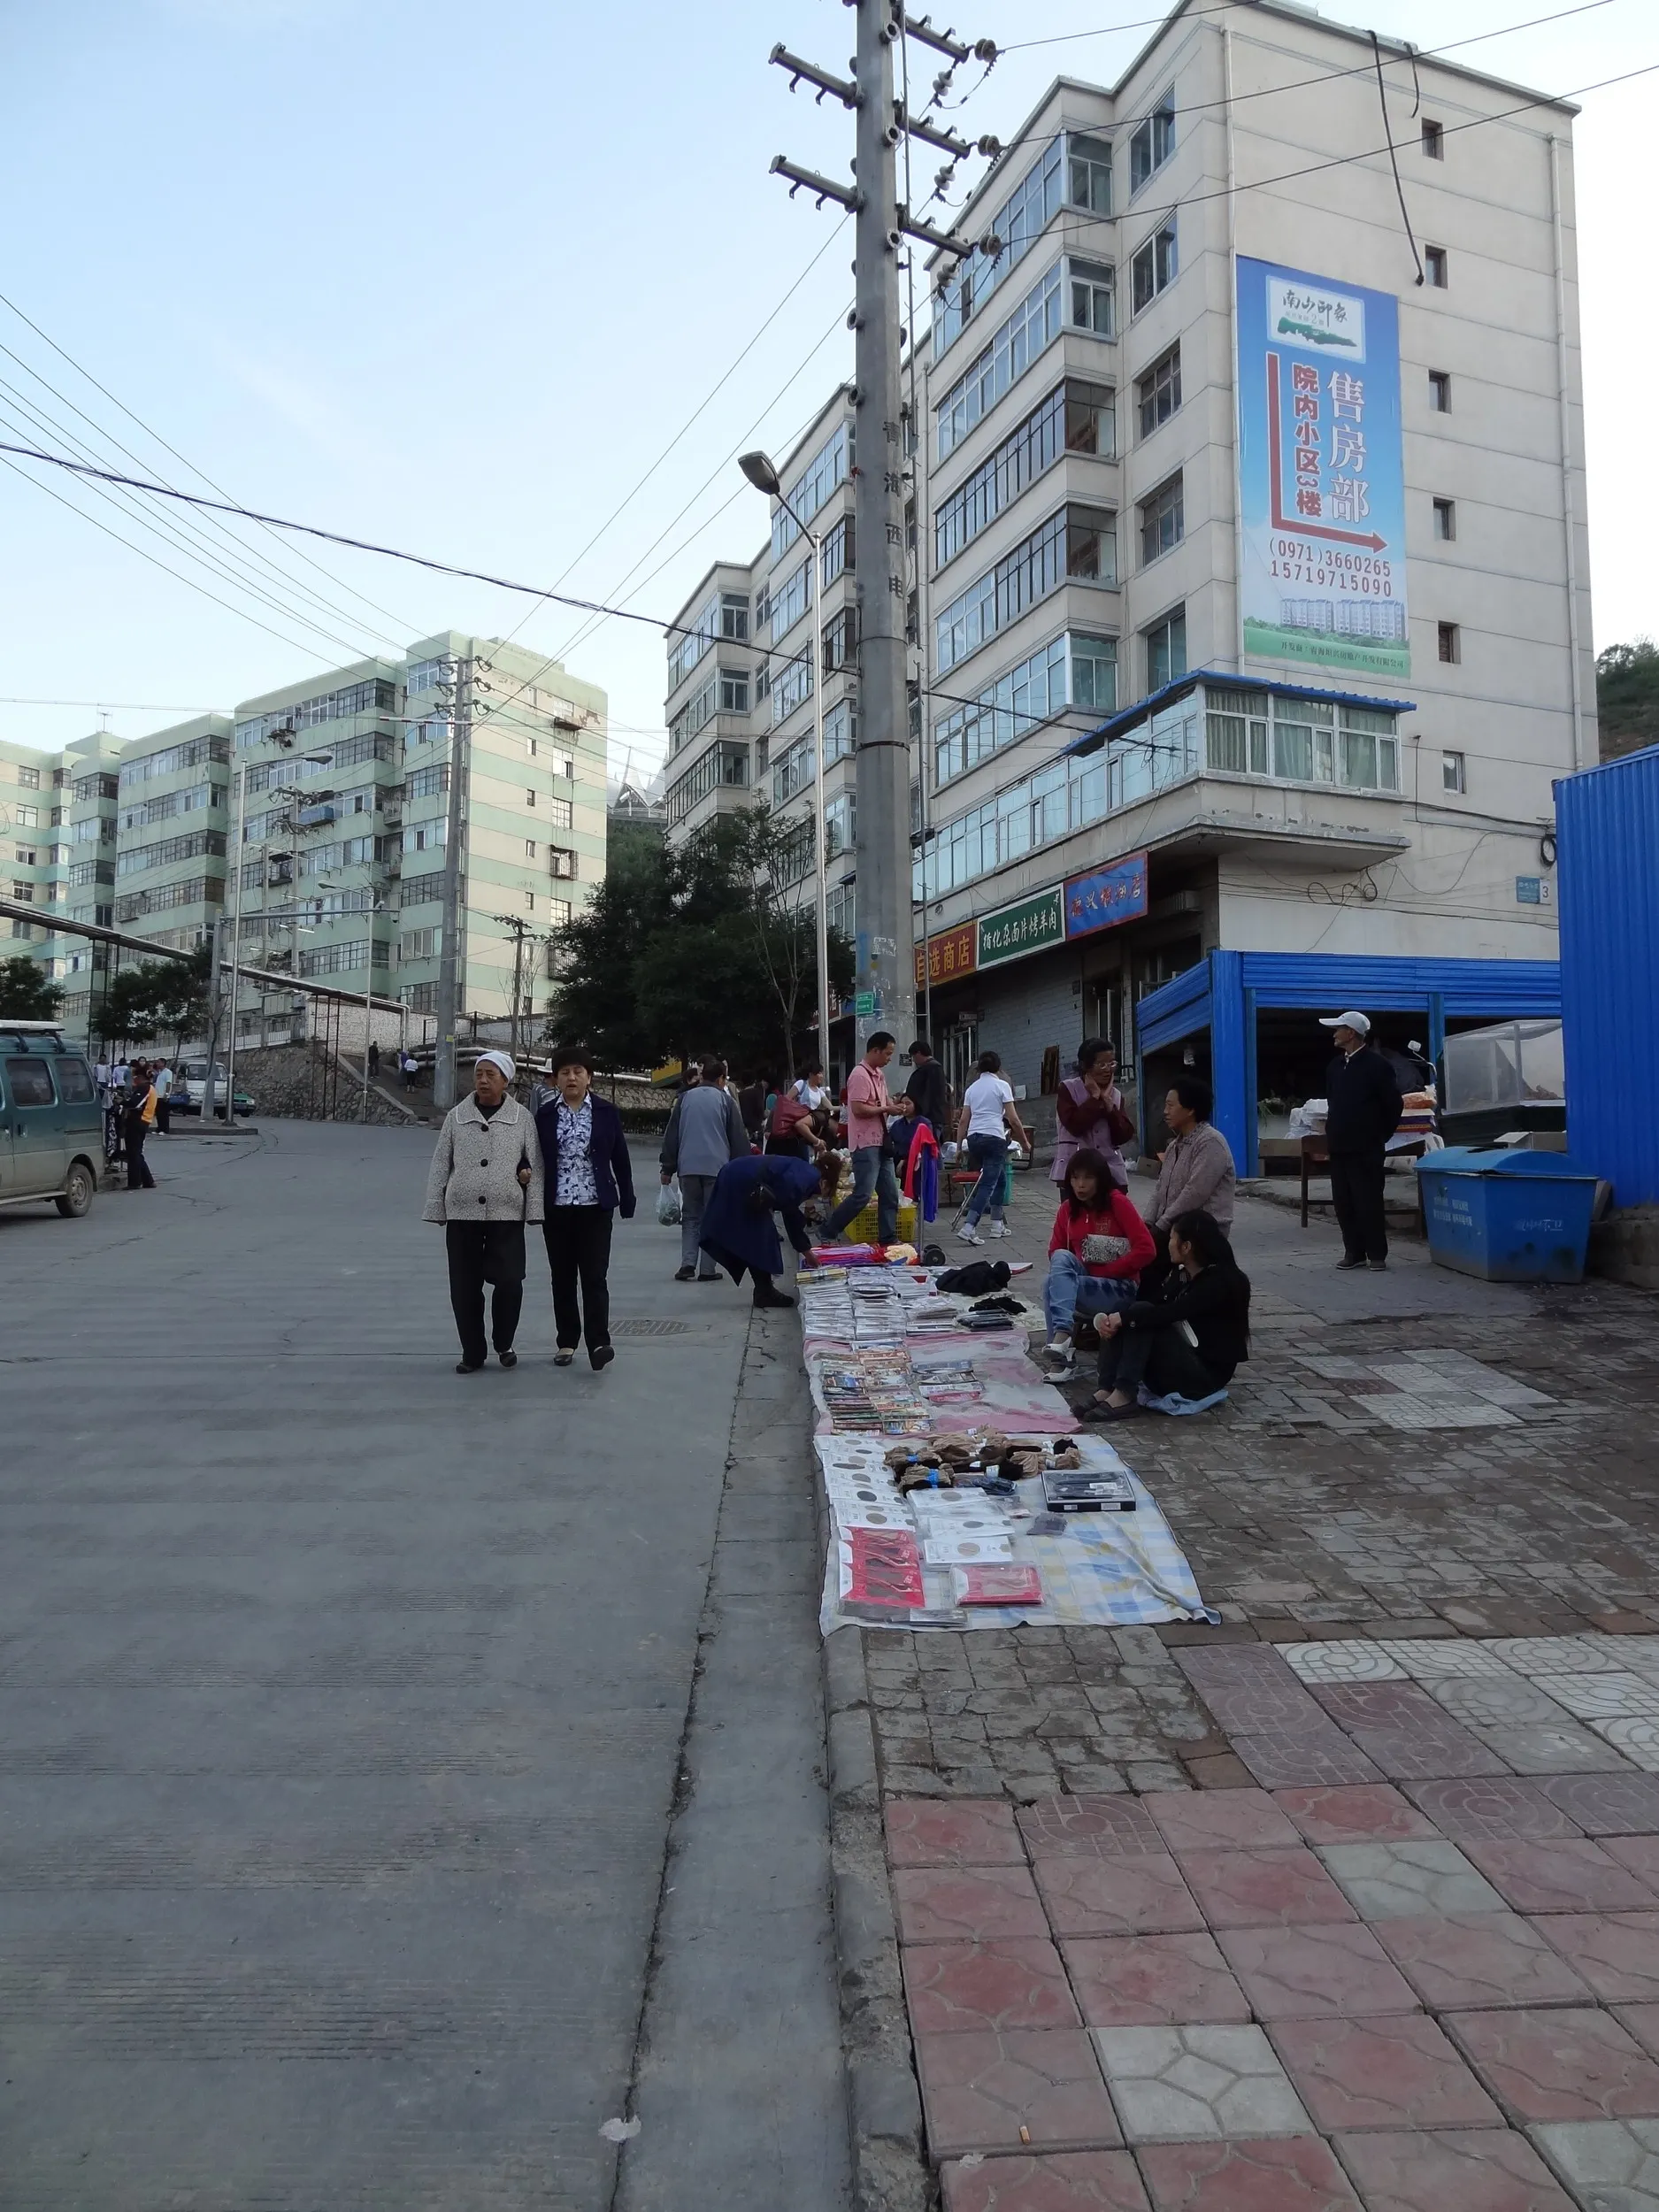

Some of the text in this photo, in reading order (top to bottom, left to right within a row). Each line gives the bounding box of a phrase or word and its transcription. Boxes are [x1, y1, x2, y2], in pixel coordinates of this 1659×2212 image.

[1292, 362, 1322, 518] 院内小区3楼
[1327, 372, 1371, 524] 售房部
[1270, 537, 1391, 577] (0971)3660265
[1271, 560, 1392, 597] 15719715090
[1542, 885, 1549, 898] 3
[917, 935, 970, 983] 自选商店
